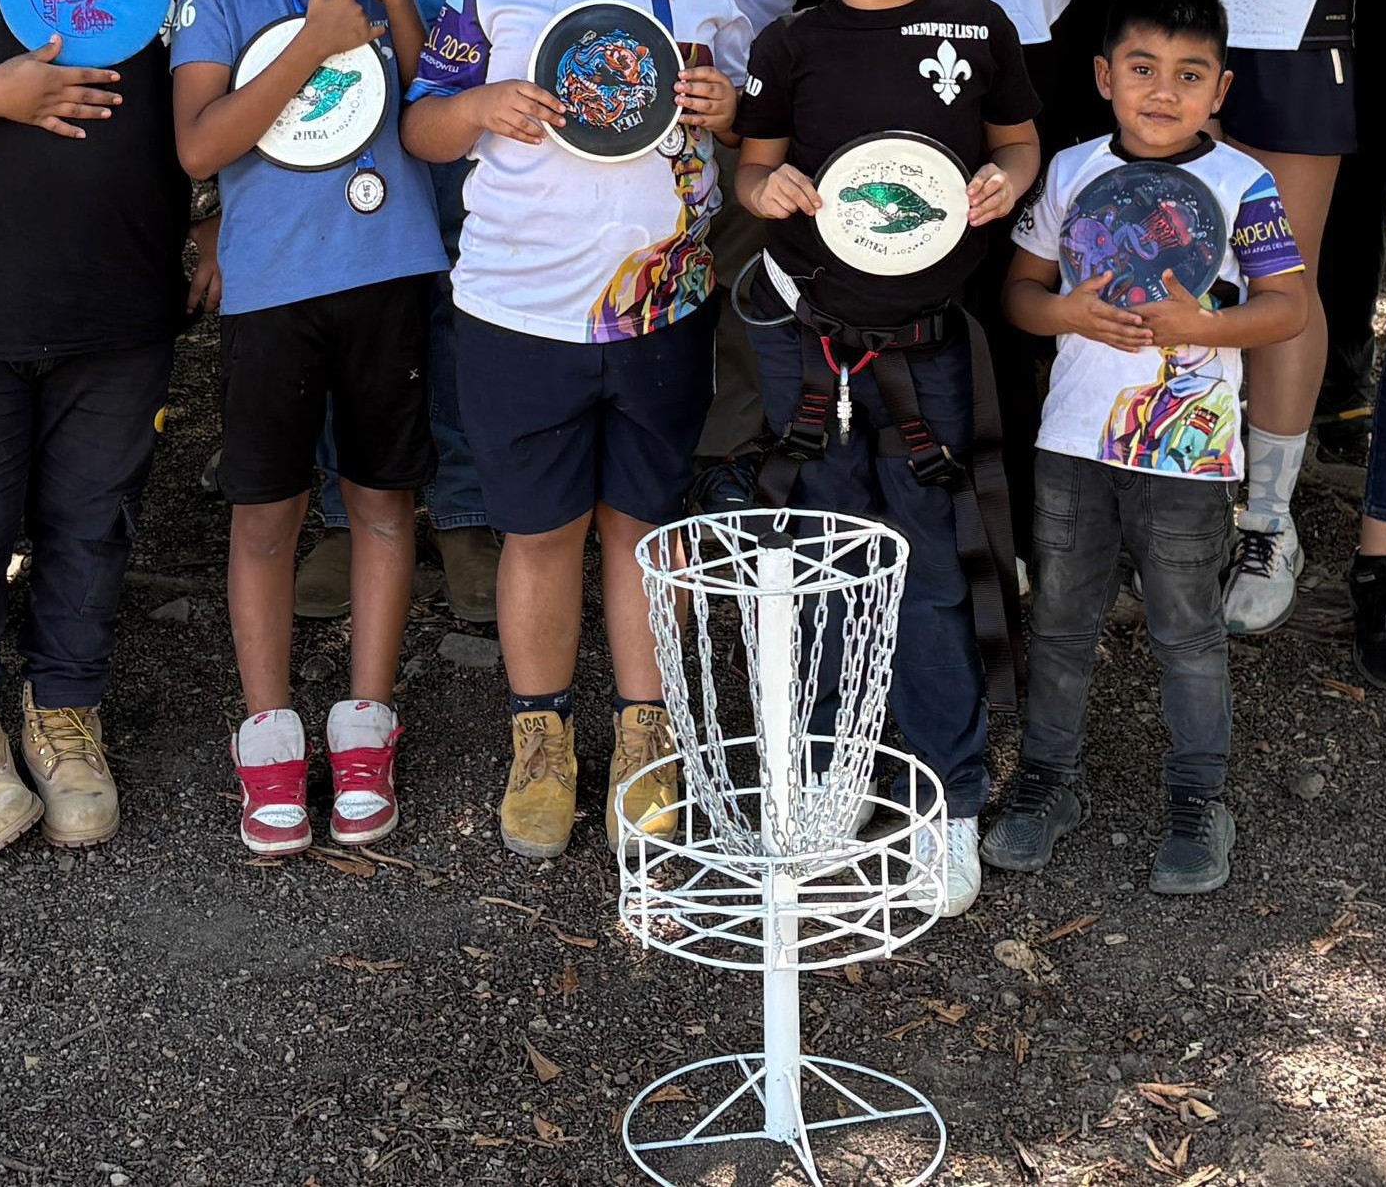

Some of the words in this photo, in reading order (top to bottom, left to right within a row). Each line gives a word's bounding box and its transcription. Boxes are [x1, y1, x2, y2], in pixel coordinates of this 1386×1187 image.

[901, 22, 953, 38] SIEMPRE
[954, 24, 989, 40] LISTO
[439, 35, 481, 64] 2026
[524, 715, 548, 732] CAT
[637, 708, 663, 725] CAT
